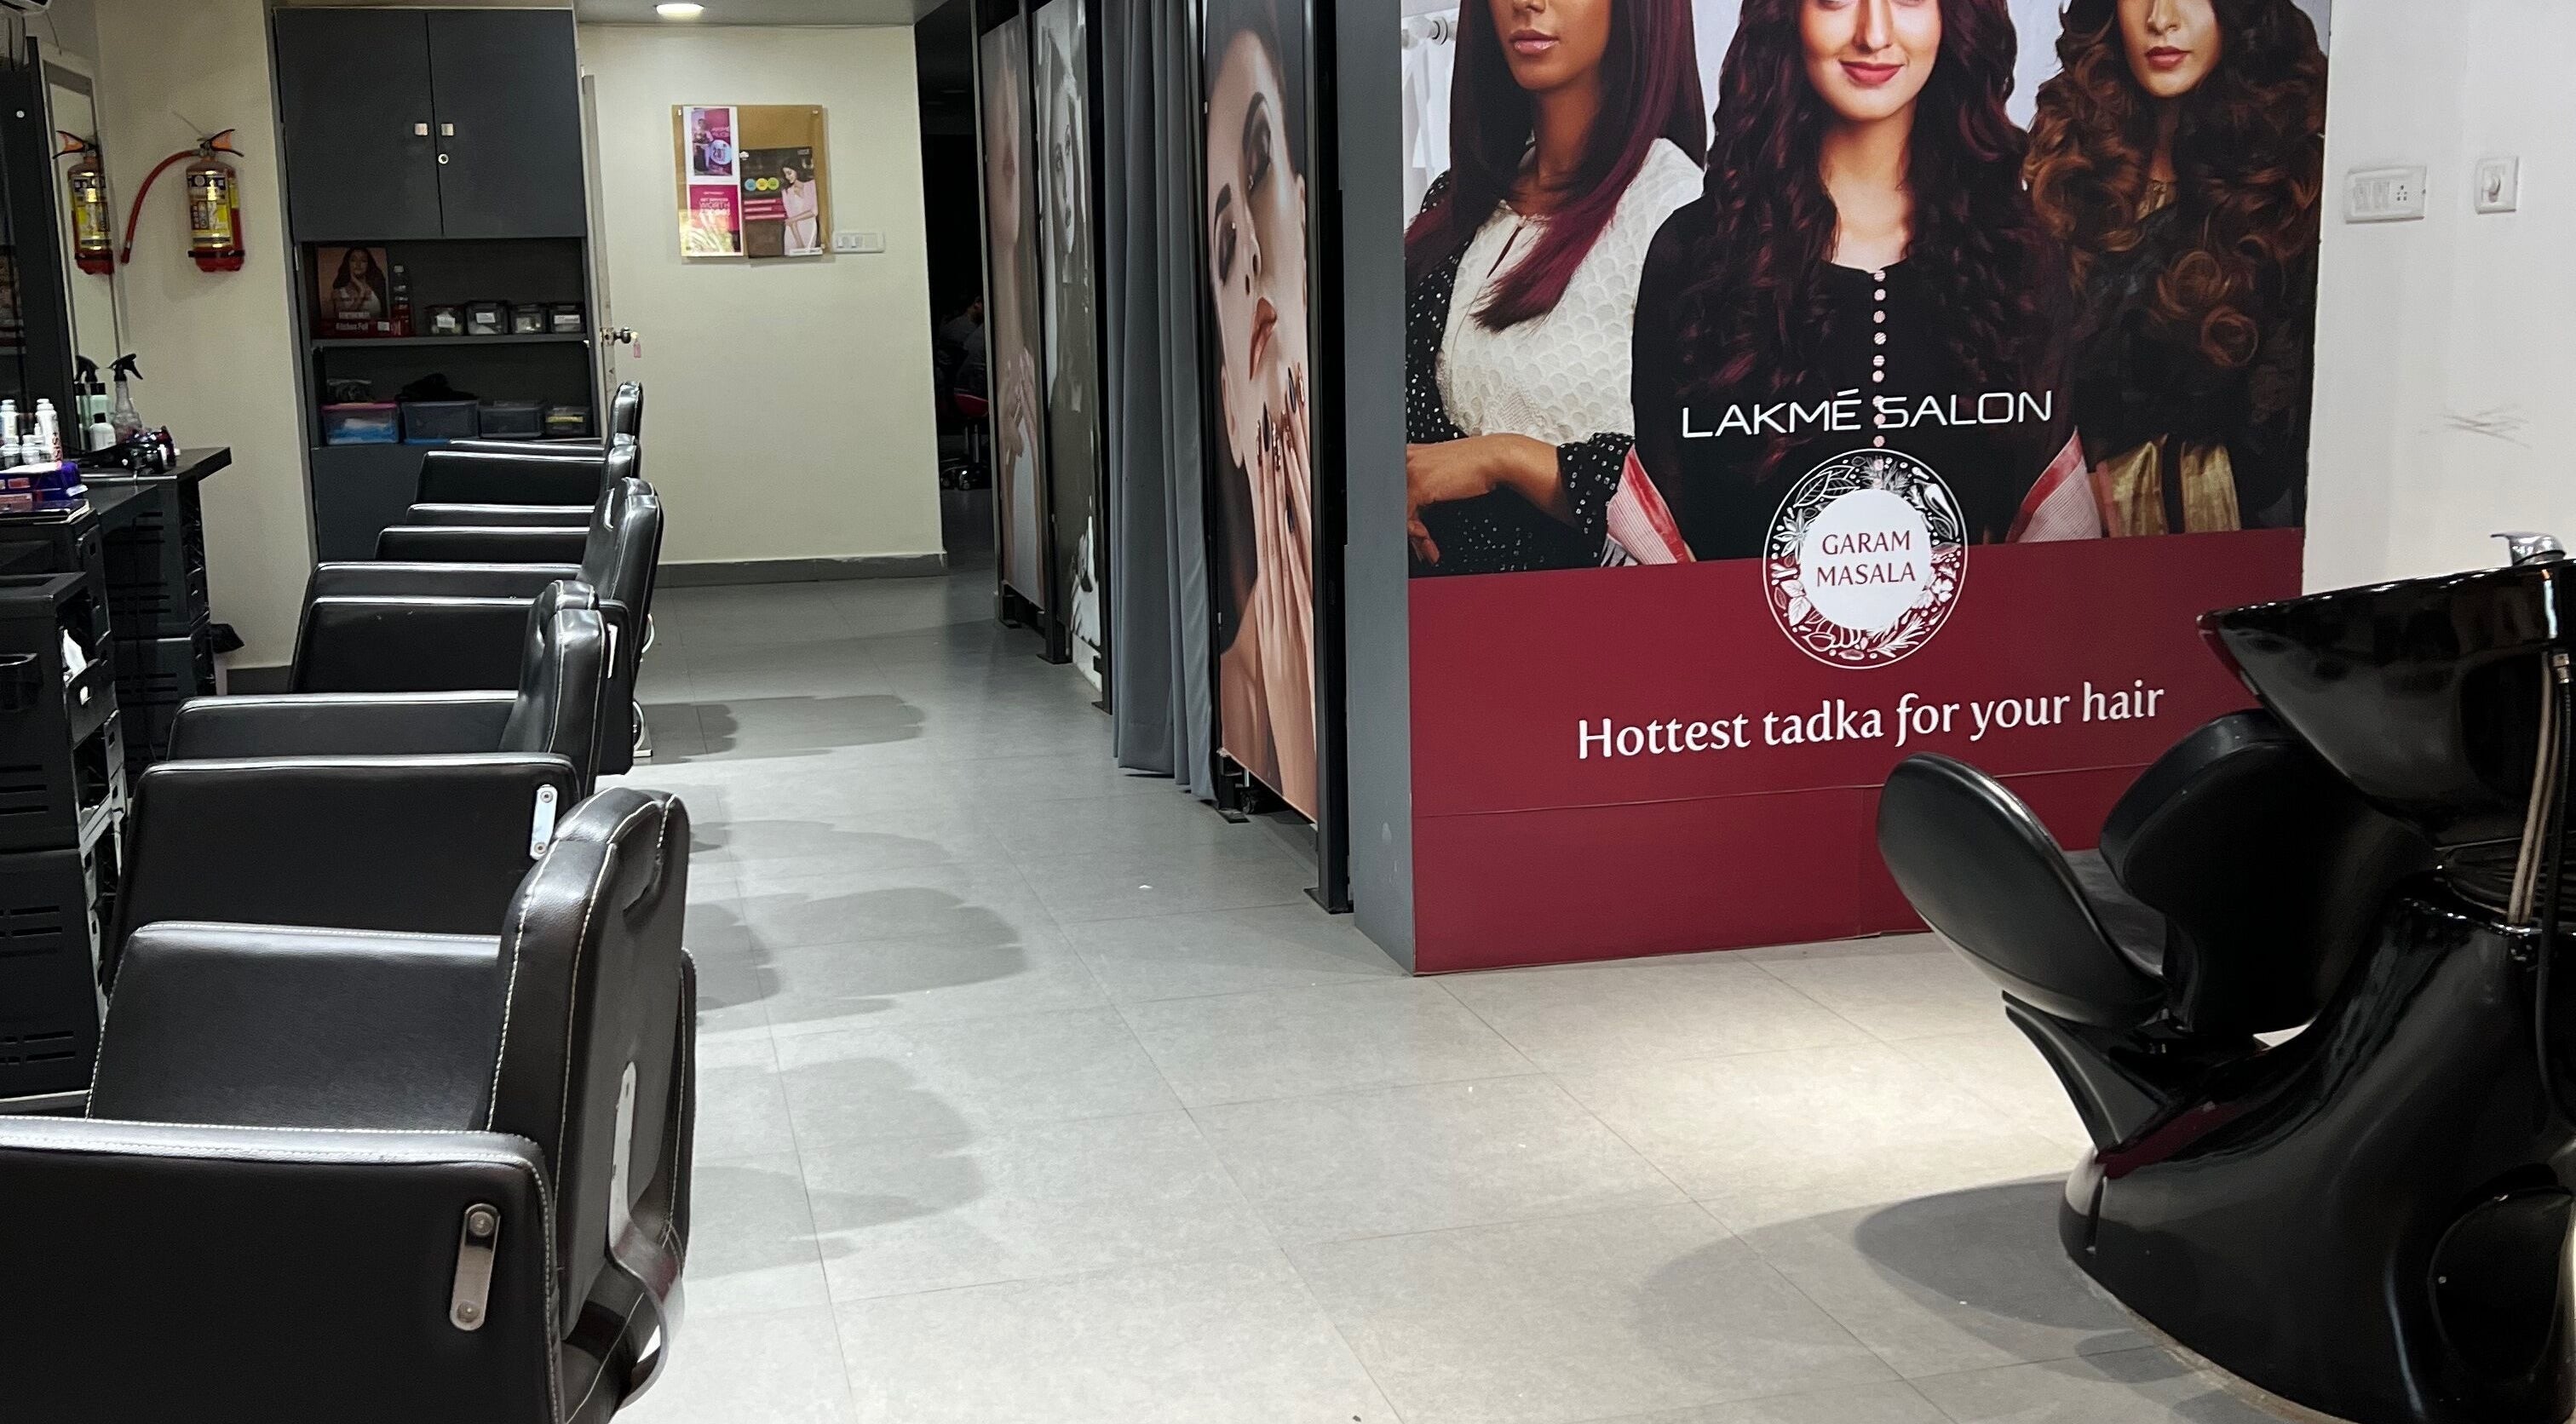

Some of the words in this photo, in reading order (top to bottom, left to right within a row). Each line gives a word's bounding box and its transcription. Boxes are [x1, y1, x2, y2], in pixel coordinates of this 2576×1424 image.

[1682, 388, 1862, 439] LAKMÉ
[1876, 390, 2052, 429] SALON
[1821, 530, 1911, 555] GARAM
[1816, 560, 1916, 588] MASALA
[1578, 713, 1751, 760] Hottest
[1762, 698, 1884, 746] tadka
[1894, 692, 1960, 748] for
[1969, 695, 2071, 742] your
[2082, 679, 2165, 722] hair
